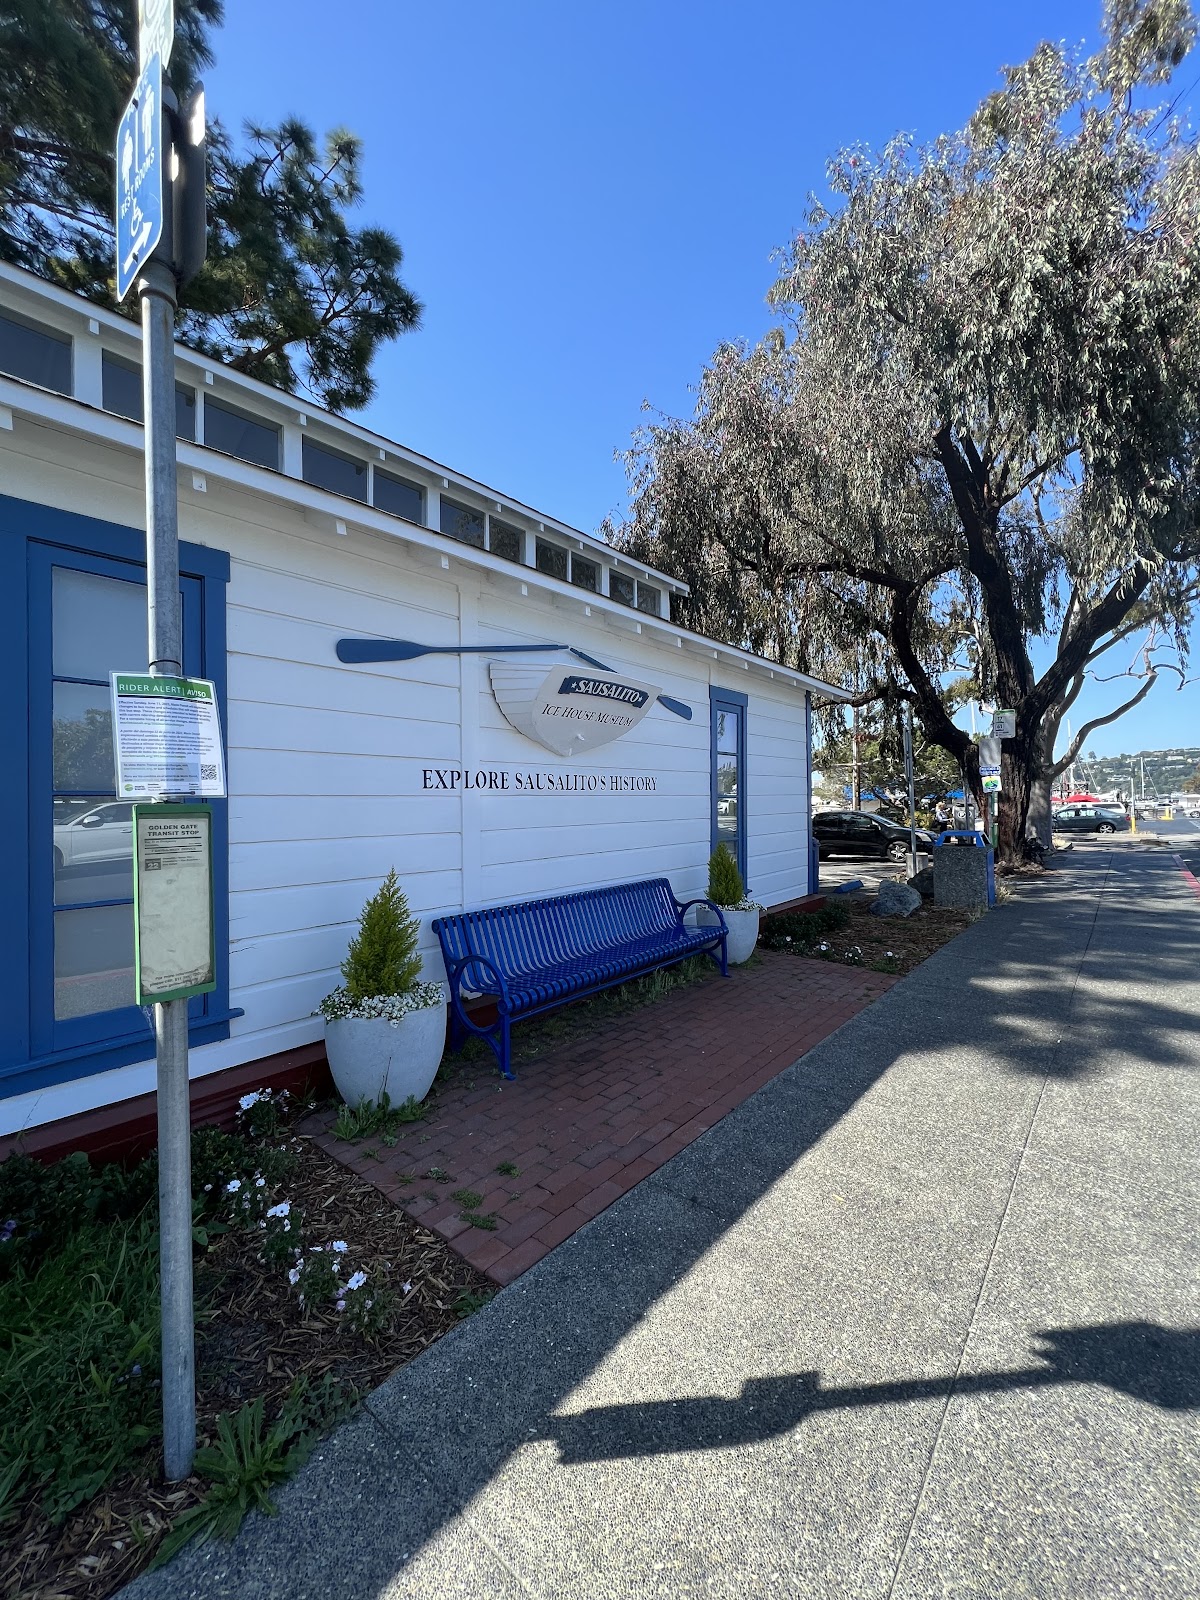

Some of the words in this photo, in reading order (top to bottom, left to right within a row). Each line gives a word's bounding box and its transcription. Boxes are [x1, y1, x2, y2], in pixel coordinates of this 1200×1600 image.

[121, 184, 134, 219] REST
[134, 147, 155, 193] ROOMS
[119, 683, 150, 692] RIDER
[152, 684, 181, 694] ALERT
[186, 688, 206, 698] AVISO
[575, 679, 640, 703] SAUSALITO
[541, 703, 560, 717] ICE
[561, 706, 597, 722] HOUSE
[597, 711, 635, 727] MUSEUM
[421, 769, 510, 790] EXPLORE
[515, 772, 607, 791] SAUSALITO'S
[609, 775, 658, 791] HISTORY
[147, 862, 159, 870] 22
